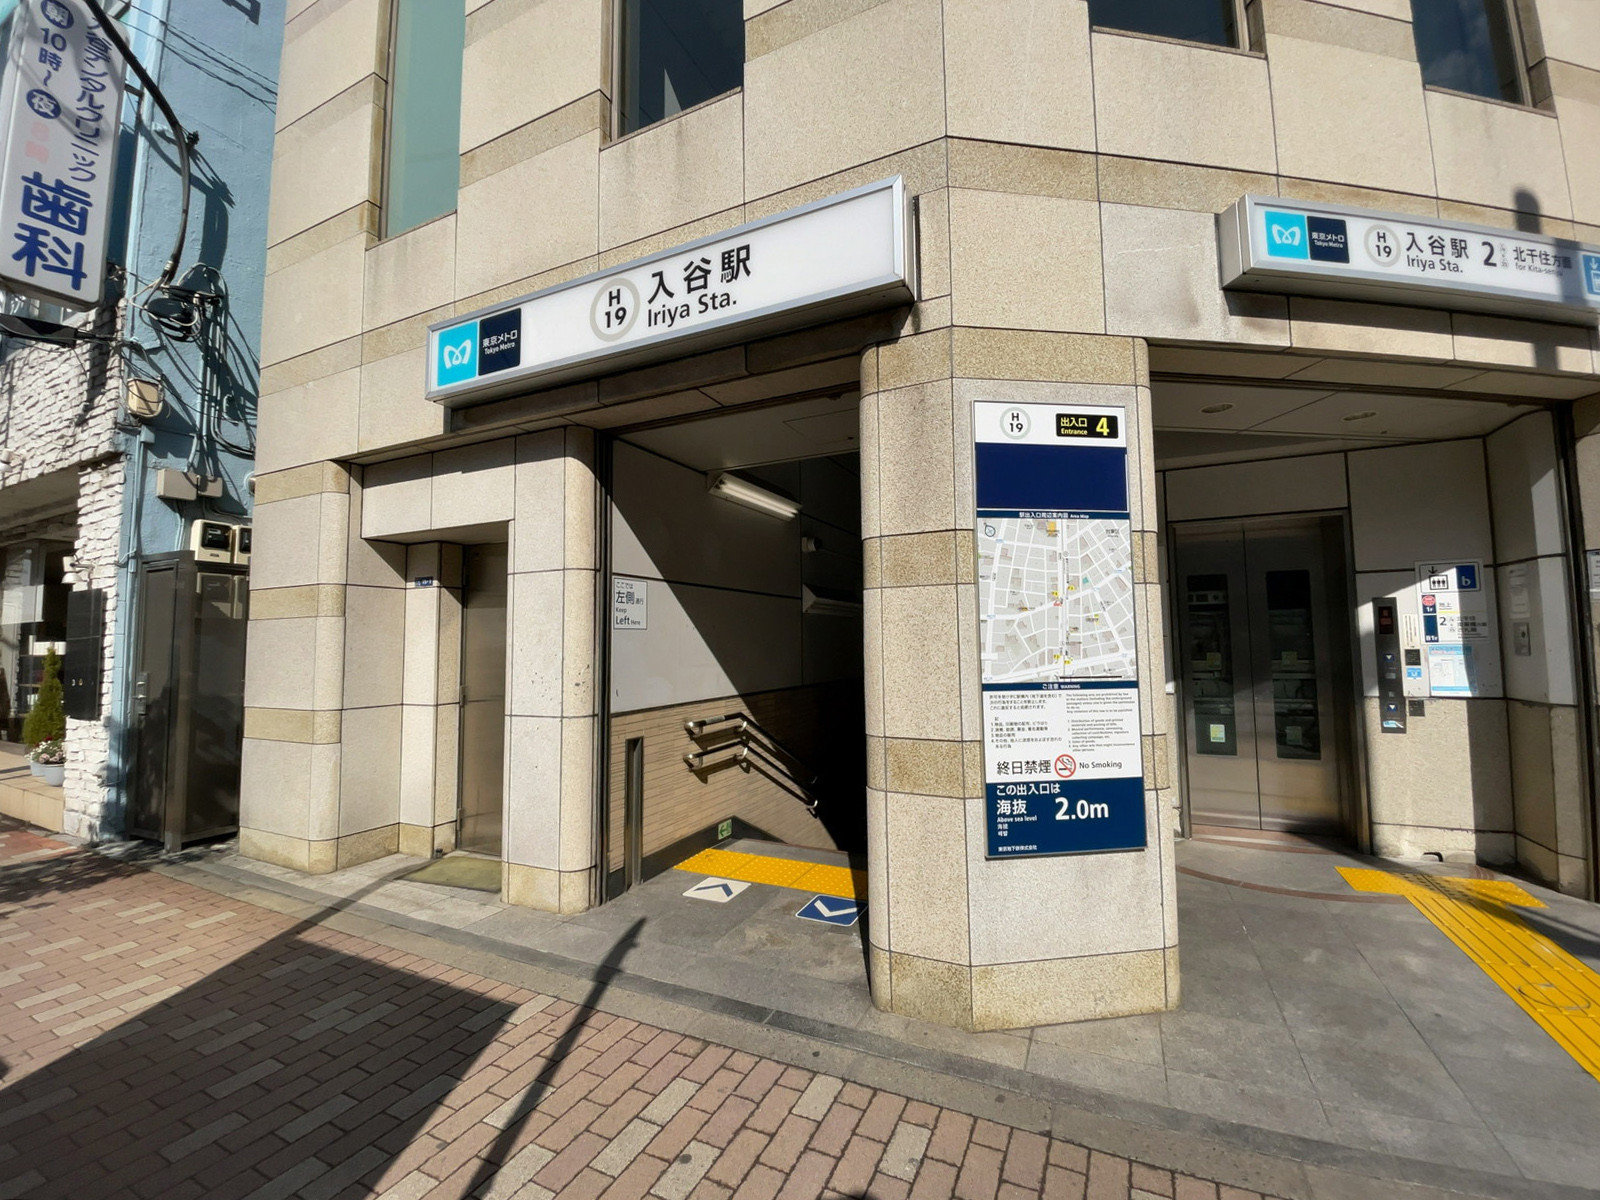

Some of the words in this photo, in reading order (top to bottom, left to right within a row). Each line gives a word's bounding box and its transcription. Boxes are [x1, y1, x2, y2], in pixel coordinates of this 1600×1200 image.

[12, 171, 93, 291] 歯科
[1311, 231, 1345, 242] 東京メトロ
[1377, 231, 1387, 243] H
[1314, 240, 1328, 248] Tokyo
[1329, 241, 1343, 249] Metro
[1375, 244, 1392, 258] 19
[1406, 232, 1469, 260] 入谷駅
[1482, 241, 1497, 267] 2
[1407, 254, 1436, 272] Iriya
[1439, 258, 1463, 273] Sta.
[648, 244, 752, 305] 入谷駅
[608, 288, 621, 307] H
[604, 306, 627, 328] 19
[648, 303, 690, 328] Iriya
[698, 292, 737, 314] Sta.
[482, 330, 518, 348] 東京メトロ
[485, 346, 499, 355] Tokyo
[500, 342, 515, 350] Metro
[1011, 412, 1020, 421] H
[1009, 422, 1024, 432] 19
[1060, 417, 1087, 428] 出入口
[1095, 416, 1110, 436] 4
[1061, 428, 1088, 436] Entrance
[1461, 576, 1471, 587] b
[616, 615, 630, 625] Left
[1439, 616, 1447, 626] 2
[996, 760, 1052, 776] 終日禁煙
[1091, 761, 1123, 769] Smoking
[996, 783, 1061, 796] この出入口は
[996, 799, 1027, 815] 海抜
[1055, 796, 1109, 821] 2.0m
